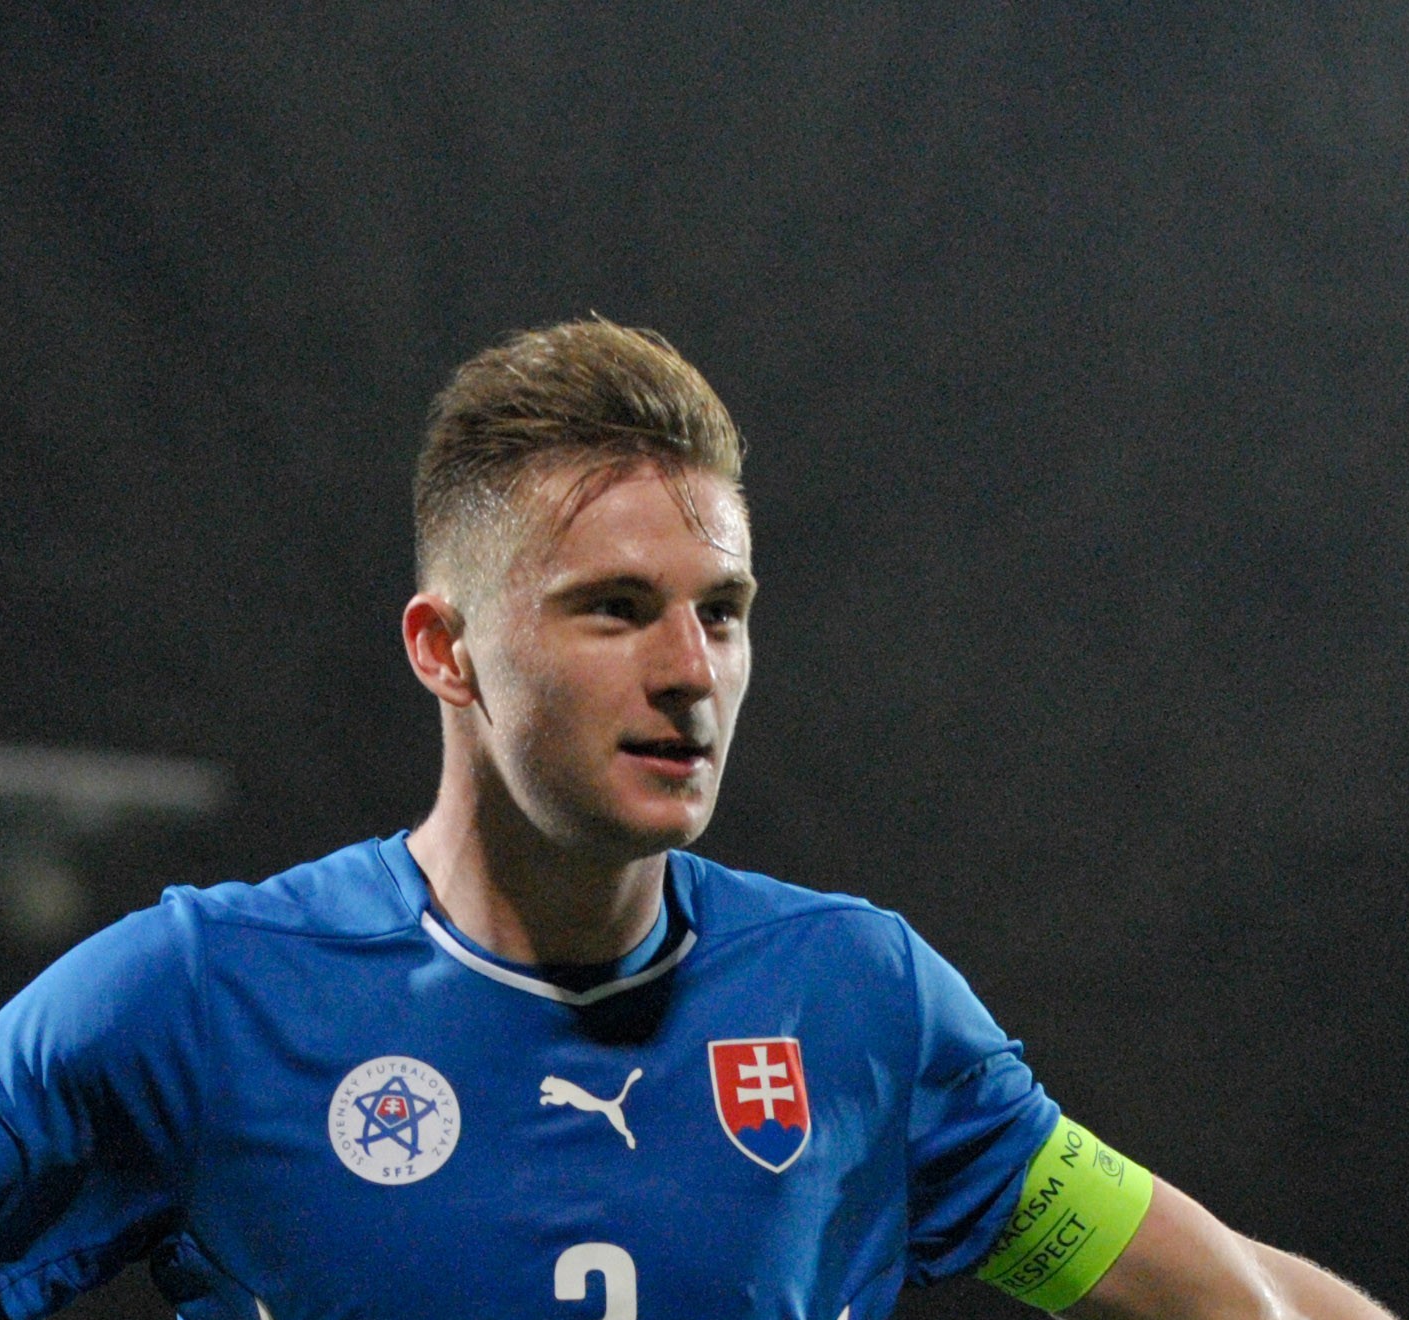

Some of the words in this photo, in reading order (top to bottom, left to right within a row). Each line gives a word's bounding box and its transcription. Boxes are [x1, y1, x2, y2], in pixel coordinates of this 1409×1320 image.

[1060, 1131, 1082, 1168] NO
[382, 1165, 416, 1178] SFZ
[1003, 1213, 1086, 1289] RESPECT
